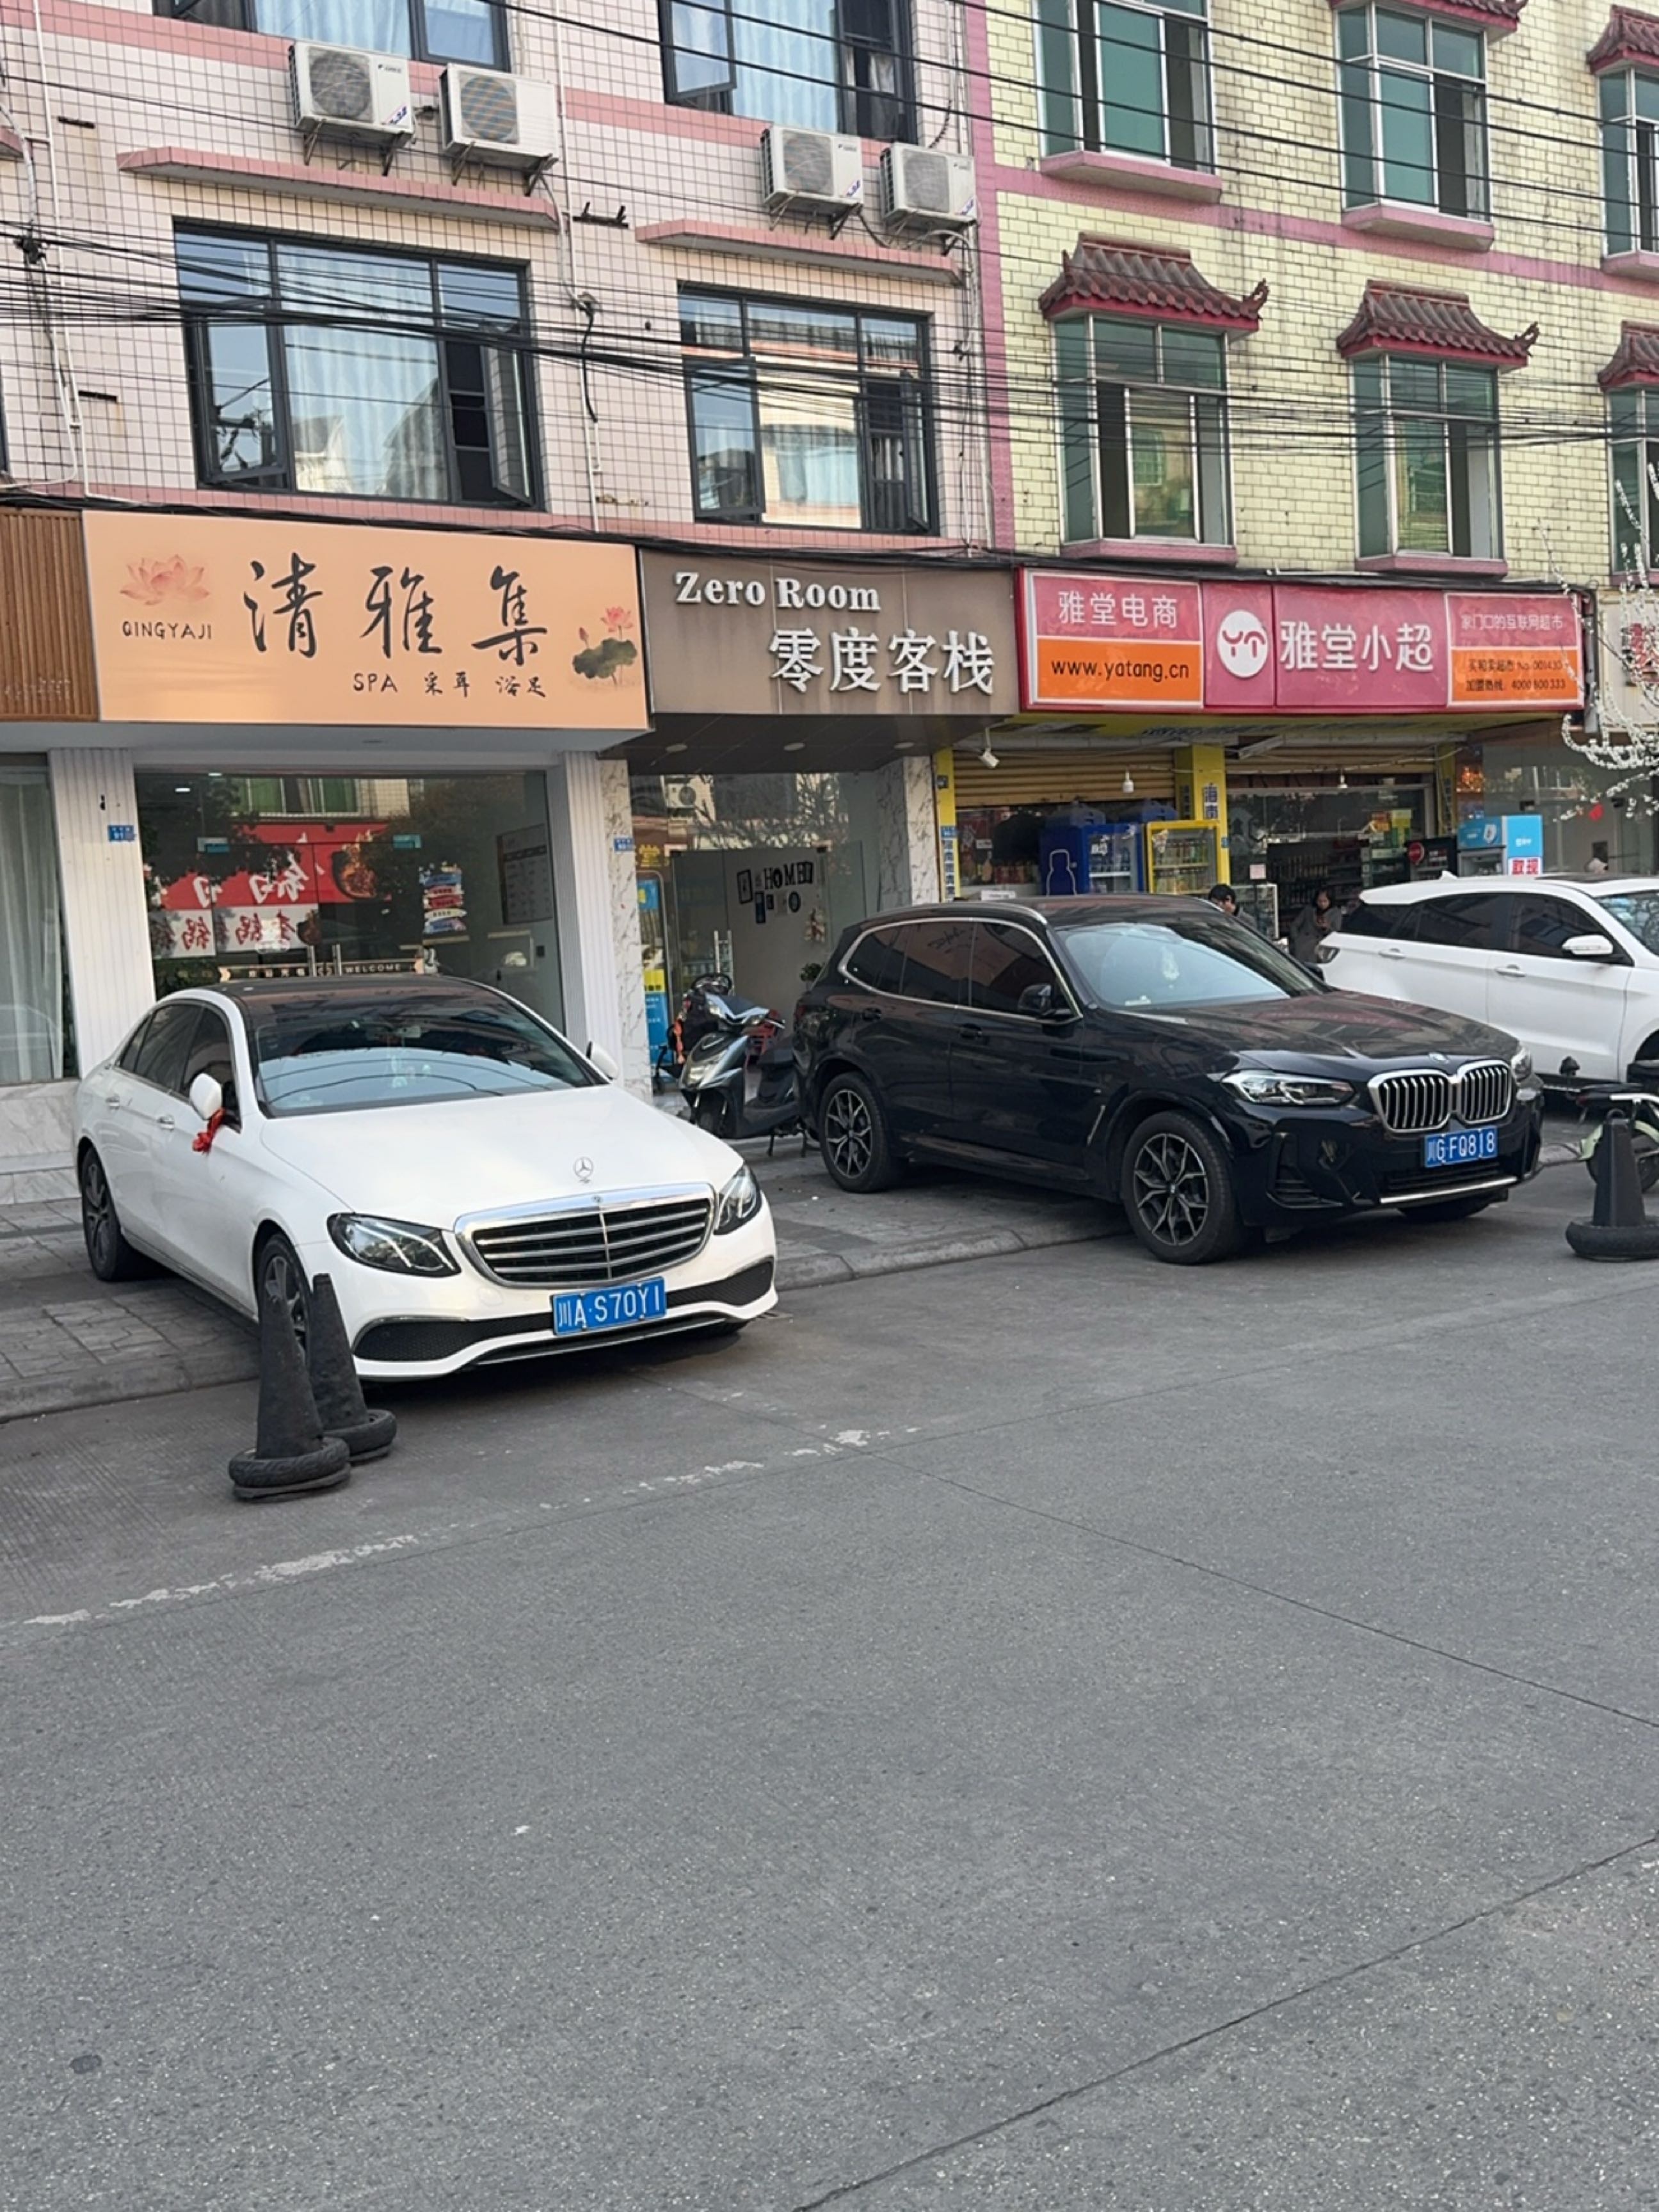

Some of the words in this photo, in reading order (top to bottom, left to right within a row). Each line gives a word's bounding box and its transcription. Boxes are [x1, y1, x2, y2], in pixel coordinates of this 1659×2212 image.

[243, 552, 549, 666] 清雅集
[675, 572, 766, 605] Zero
[775, 577, 881, 612] Room
[1058, 590, 1178, 629] 雅堂电商
[122, 620, 212, 640] QINGYAJI
[1279, 620, 1434, 673] 雅堂小超
[769, 626, 995, 696] 零度客栈
[1051, 658, 1190, 683] www.yatang.cn
[353, 672, 398, 693] SPA
[424, 671, 471, 698] 采耳
